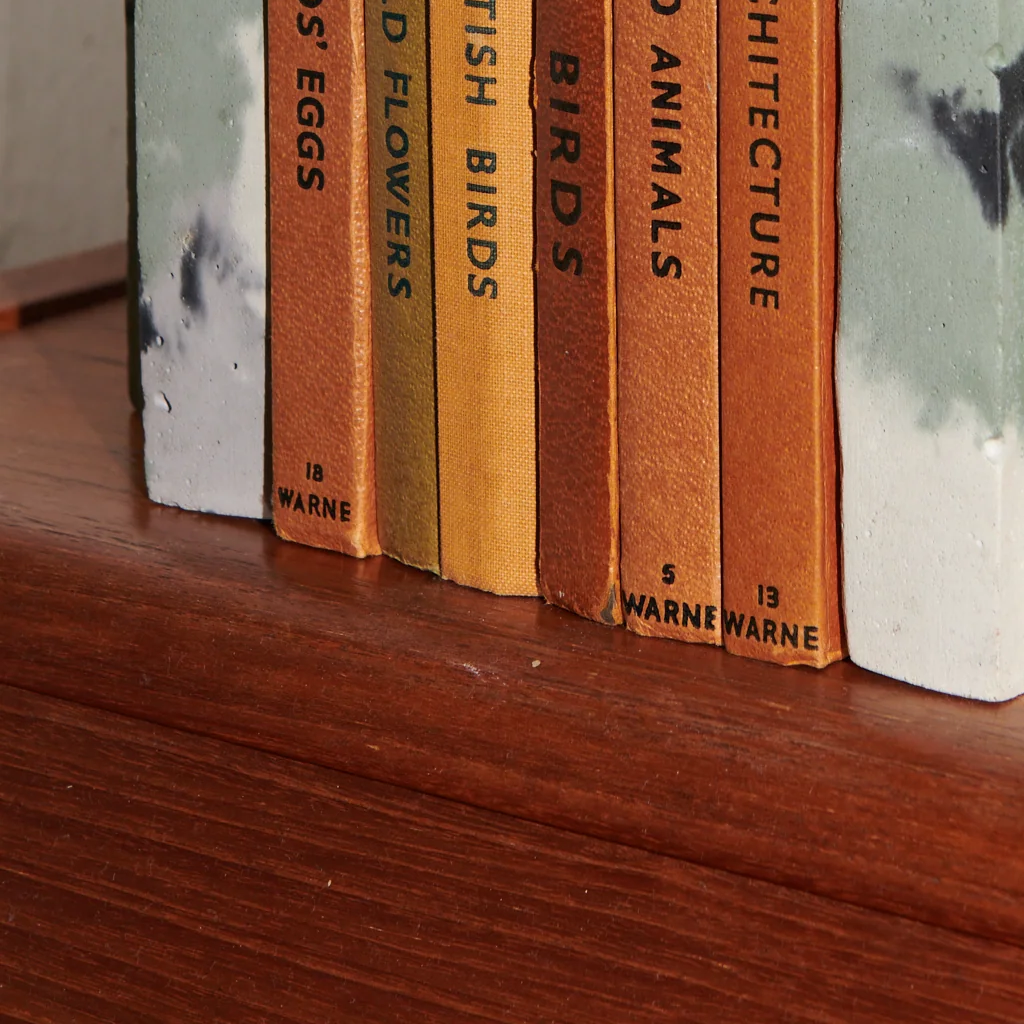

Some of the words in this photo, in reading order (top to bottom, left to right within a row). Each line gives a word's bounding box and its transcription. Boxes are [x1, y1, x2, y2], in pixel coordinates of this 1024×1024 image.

[296, 68, 325, 192] EGGS
[549, 50, 584, 276] BIRDS
[650, 44, 683, 280] ANIMALS
[383, 69, 412, 299] FLOWERS
[466, 148, 498, 300] BIRDS
[306, 462, 323, 482] 18
[278, 486, 351, 523] WARNE
[661, 563, 675, 585] 5
[621, 589, 718, 631] WARNE
[757, 584, 780, 609] 13
[723, 608, 819, 651] WARNE
